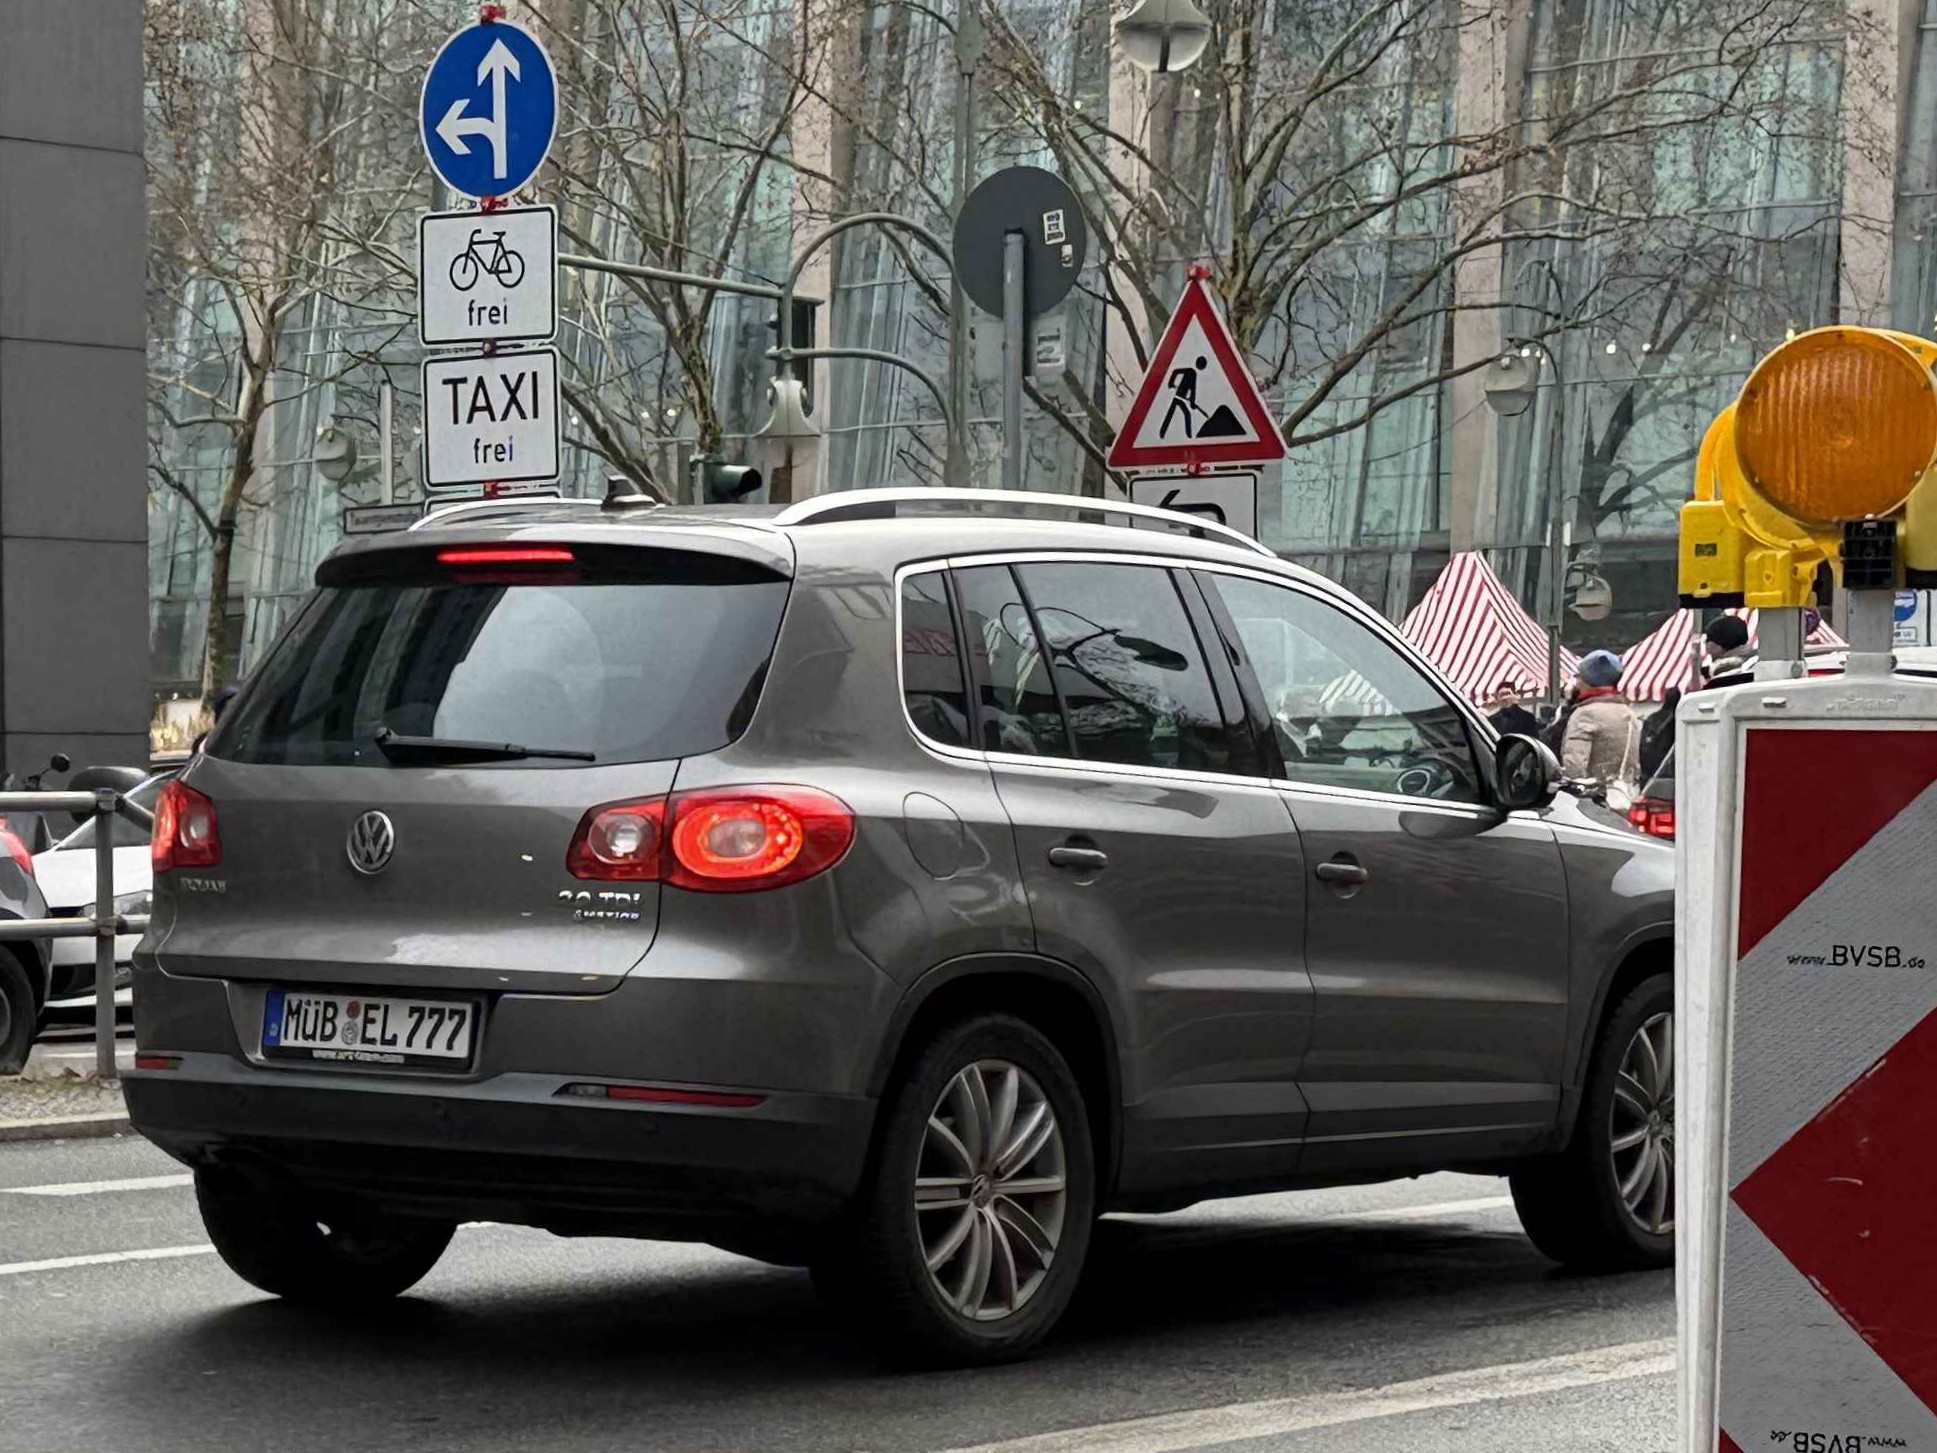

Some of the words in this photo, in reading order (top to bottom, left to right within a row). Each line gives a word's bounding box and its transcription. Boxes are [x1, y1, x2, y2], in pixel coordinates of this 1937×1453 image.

[468, 298, 508, 327] frei
[442, 371, 539, 425] TAXI
[473, 435, 514, 464] frei
[284, 998, 338, 1042] MÜB
[361, 1003, 398, 1046] EL
[406, 1006, 467, 1051] 777
